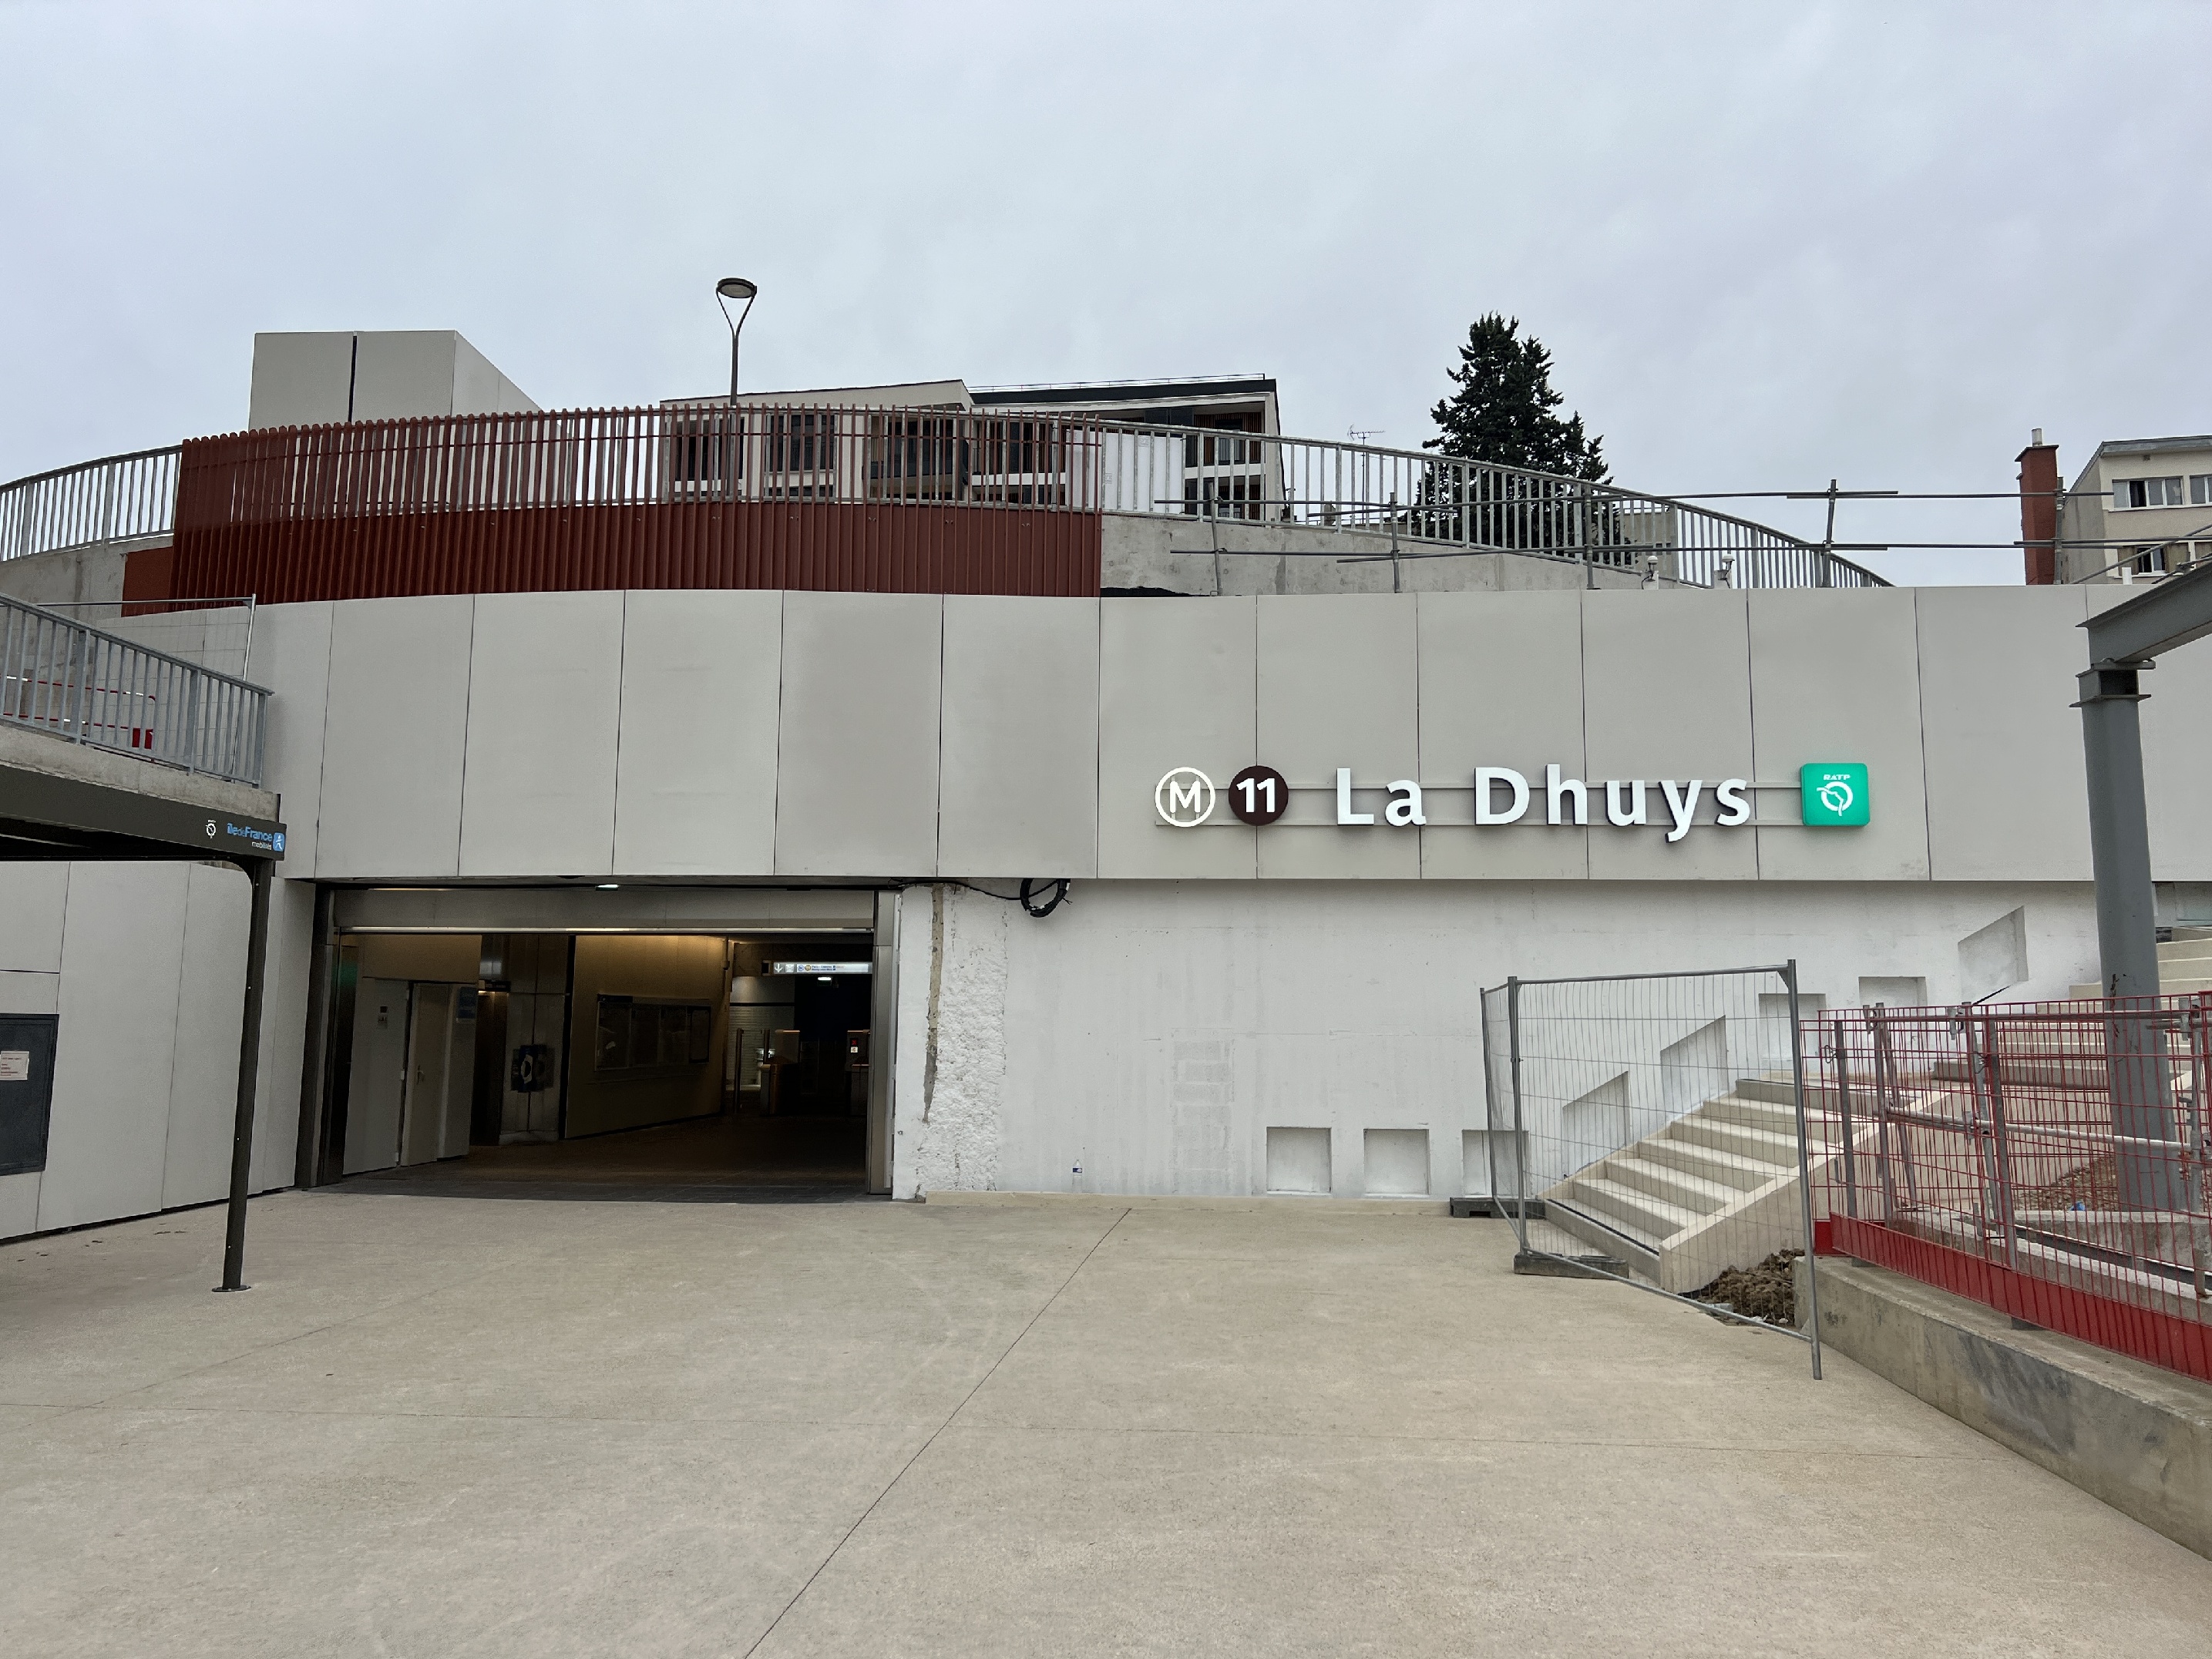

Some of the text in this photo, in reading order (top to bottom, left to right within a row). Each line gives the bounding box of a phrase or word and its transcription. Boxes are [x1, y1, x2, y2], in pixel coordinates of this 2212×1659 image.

[1235, 777, 1276, 813] 11
[1336, 767, 1427, 827] La
[1474, 764, 1750, 843] Dhuys
